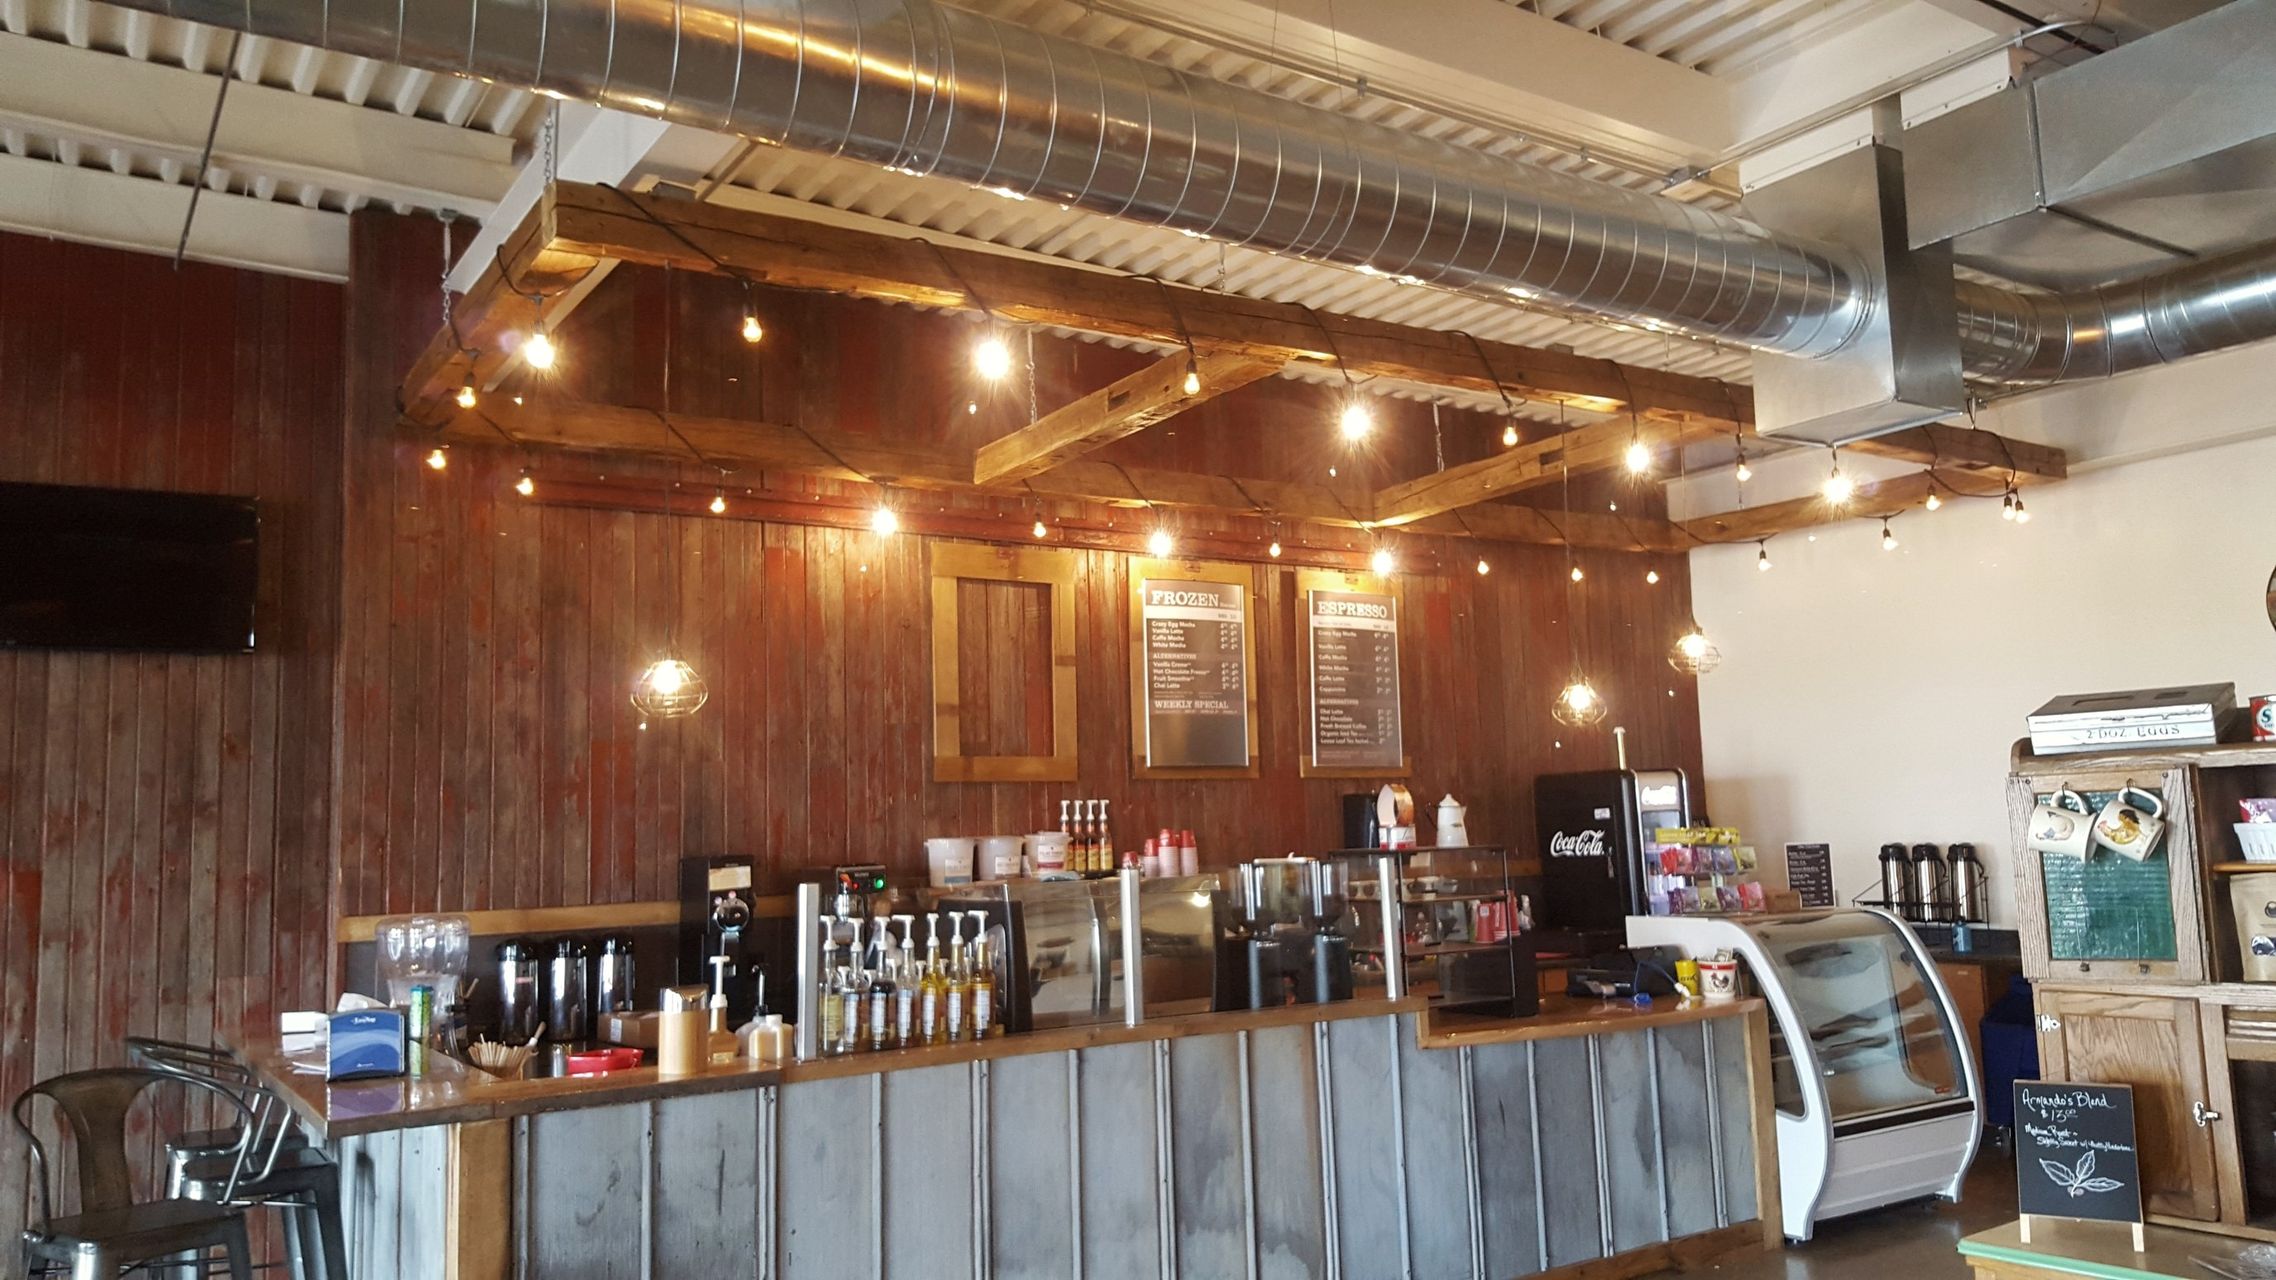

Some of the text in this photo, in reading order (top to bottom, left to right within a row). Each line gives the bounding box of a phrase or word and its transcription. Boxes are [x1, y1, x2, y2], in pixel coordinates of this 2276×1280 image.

[1152, 590, 1219, 607] FROZEN
[1318, 602, 1387, 618] ESPRESSO
[1154, 700, 1229, 709] WEEKLY SPECIAL
[2087, 729, 2094, 739] 2
[2137, 725, 2180, 737] EGGS
[1550, 830, 1605, 858] Coca-Cola
[2022, 1088, 2117, 1112] Armando's Blend
